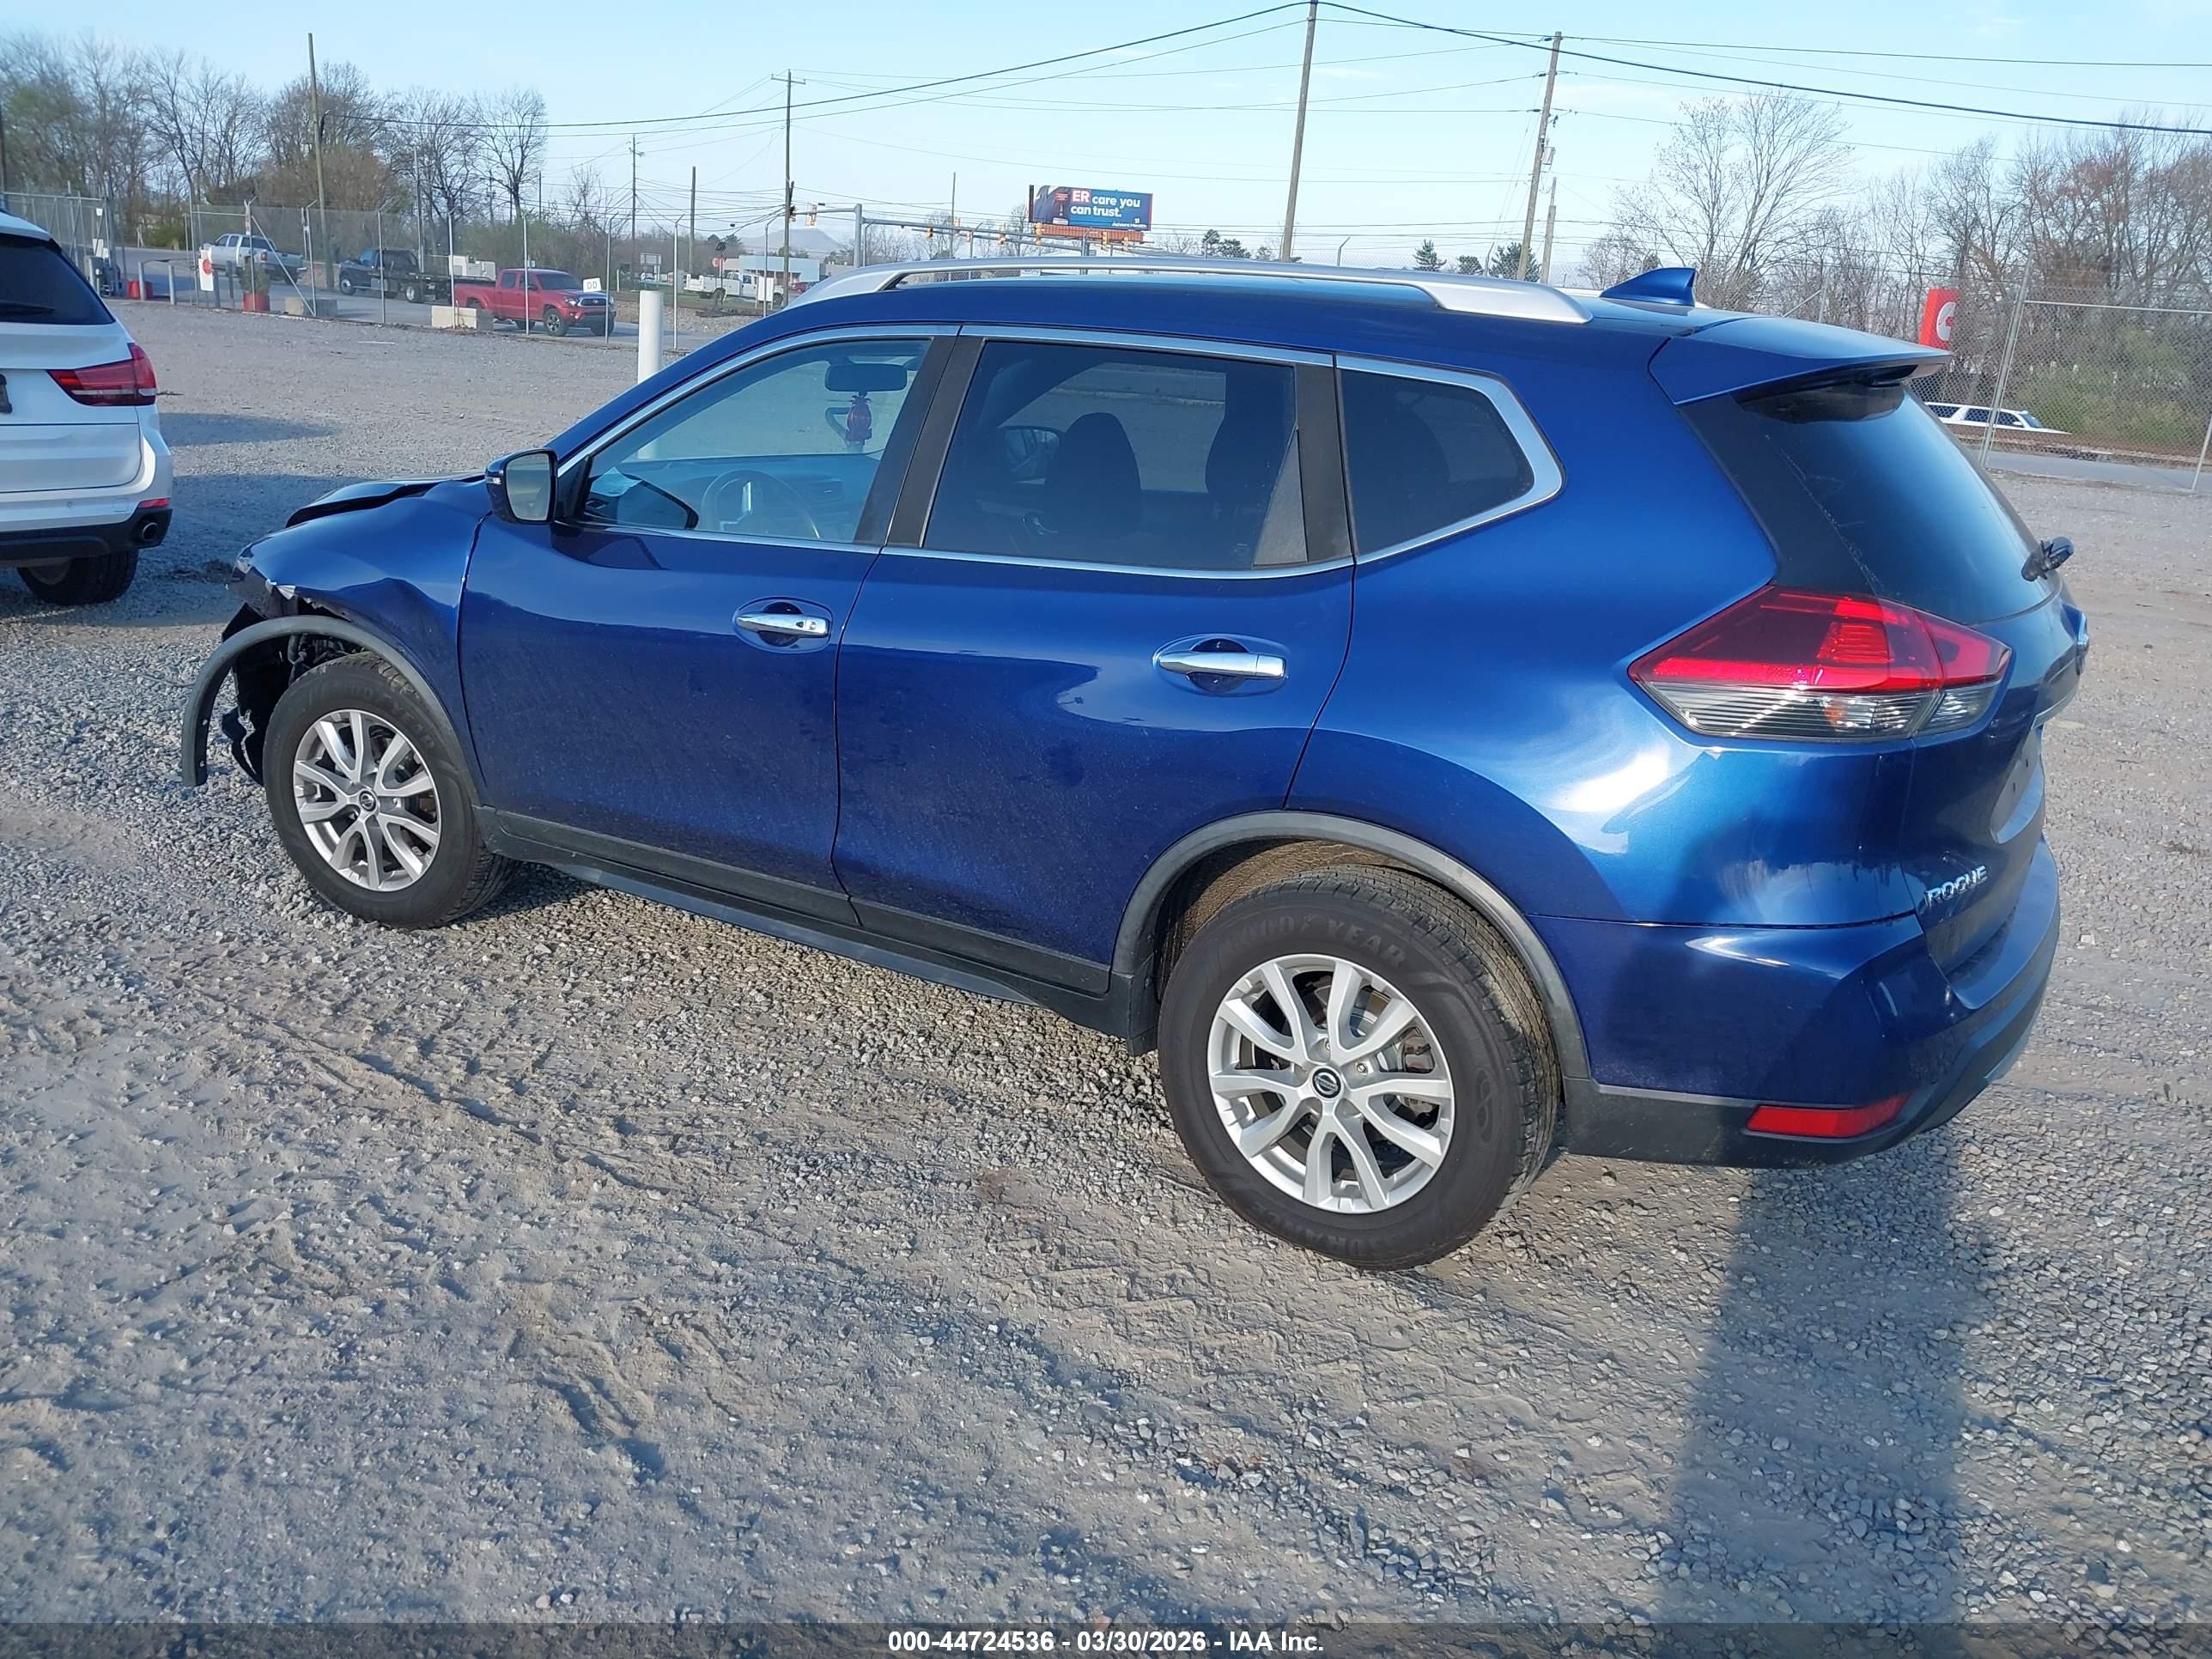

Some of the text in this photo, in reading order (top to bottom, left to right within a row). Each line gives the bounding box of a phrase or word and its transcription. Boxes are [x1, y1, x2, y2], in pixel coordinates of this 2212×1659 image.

[1072, 190, 1091, 203] ER
[1091, 195, 1118, 206] care
[1119, 197, 1141, 209] you
[1070, 204, 1122, 217] can trust.
[1924, 865, 1988, 907] ROGUE
